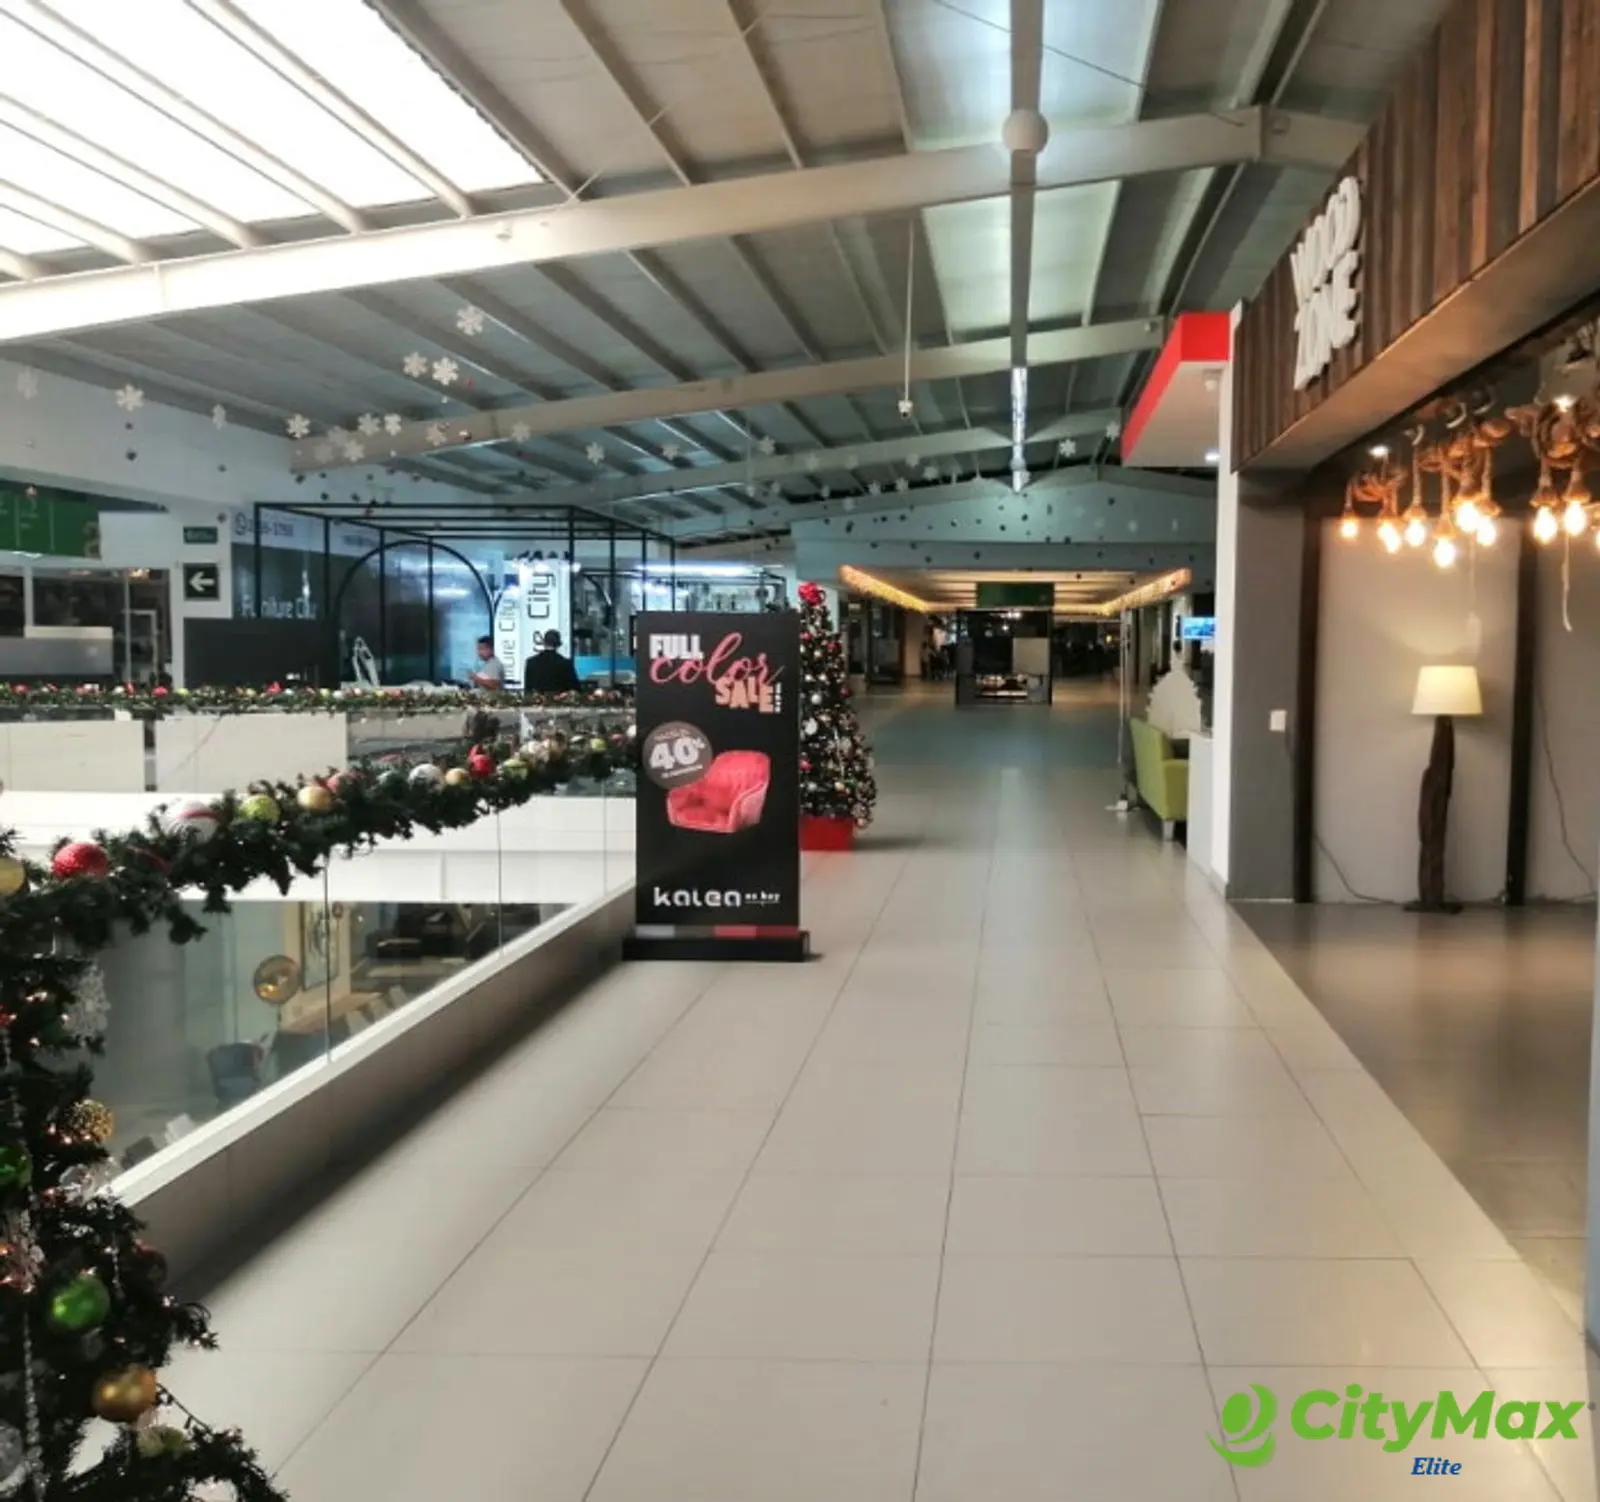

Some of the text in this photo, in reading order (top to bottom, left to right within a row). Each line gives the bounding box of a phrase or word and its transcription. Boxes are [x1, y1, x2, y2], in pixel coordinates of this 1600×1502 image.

[527, 571, 556, 619] City
[650, 634, 704, 660] FULL
[650, 632, 782, 684] color
[715, 676, 774, 713] SALE
